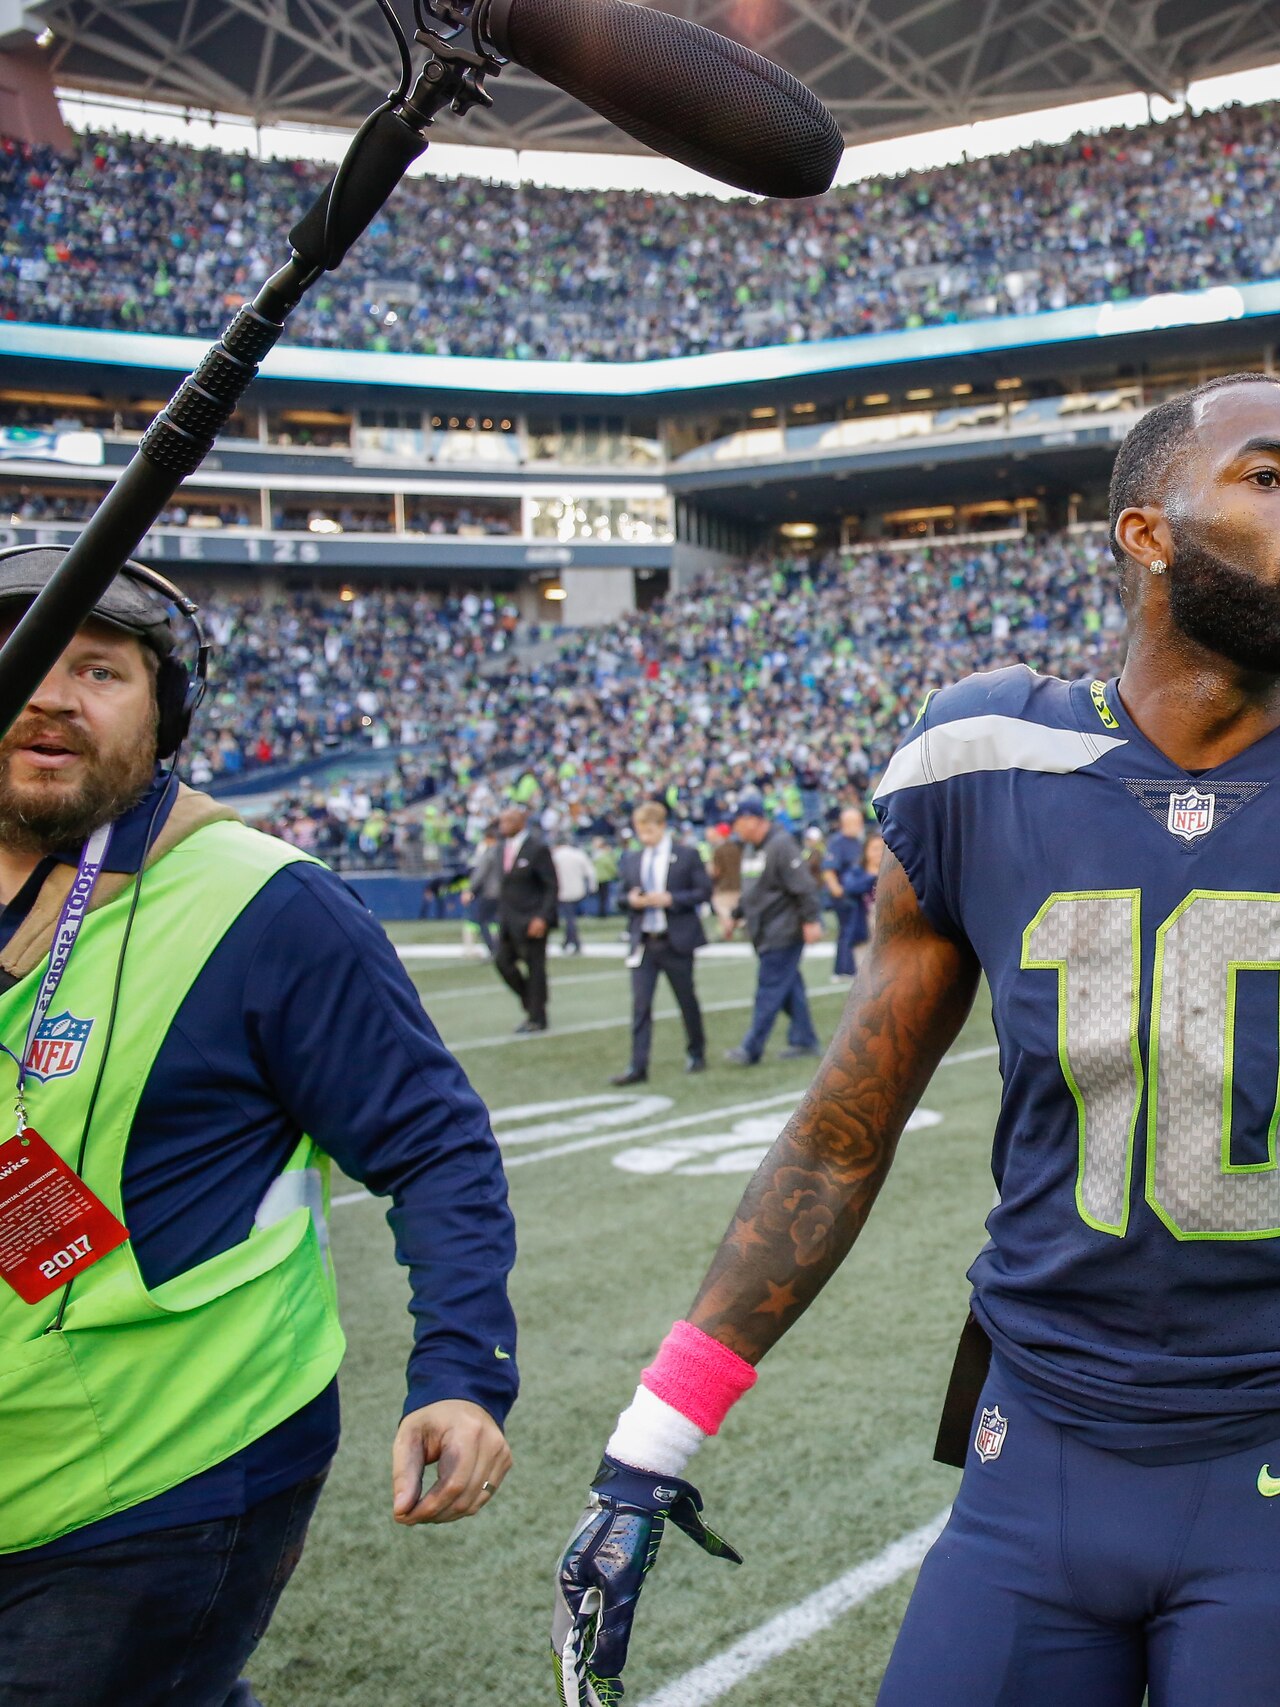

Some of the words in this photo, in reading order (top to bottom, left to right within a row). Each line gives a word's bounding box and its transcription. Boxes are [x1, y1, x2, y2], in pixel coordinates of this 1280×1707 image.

[1175, 811, 1206, 831] NFL
[26, 1040, 75, 1075] NFL
[28, 1168, 58, 1189] CONDITIONS
[39, 1234, 94, 1280] 2017
[979, 1429, 997, 1453] NFL
